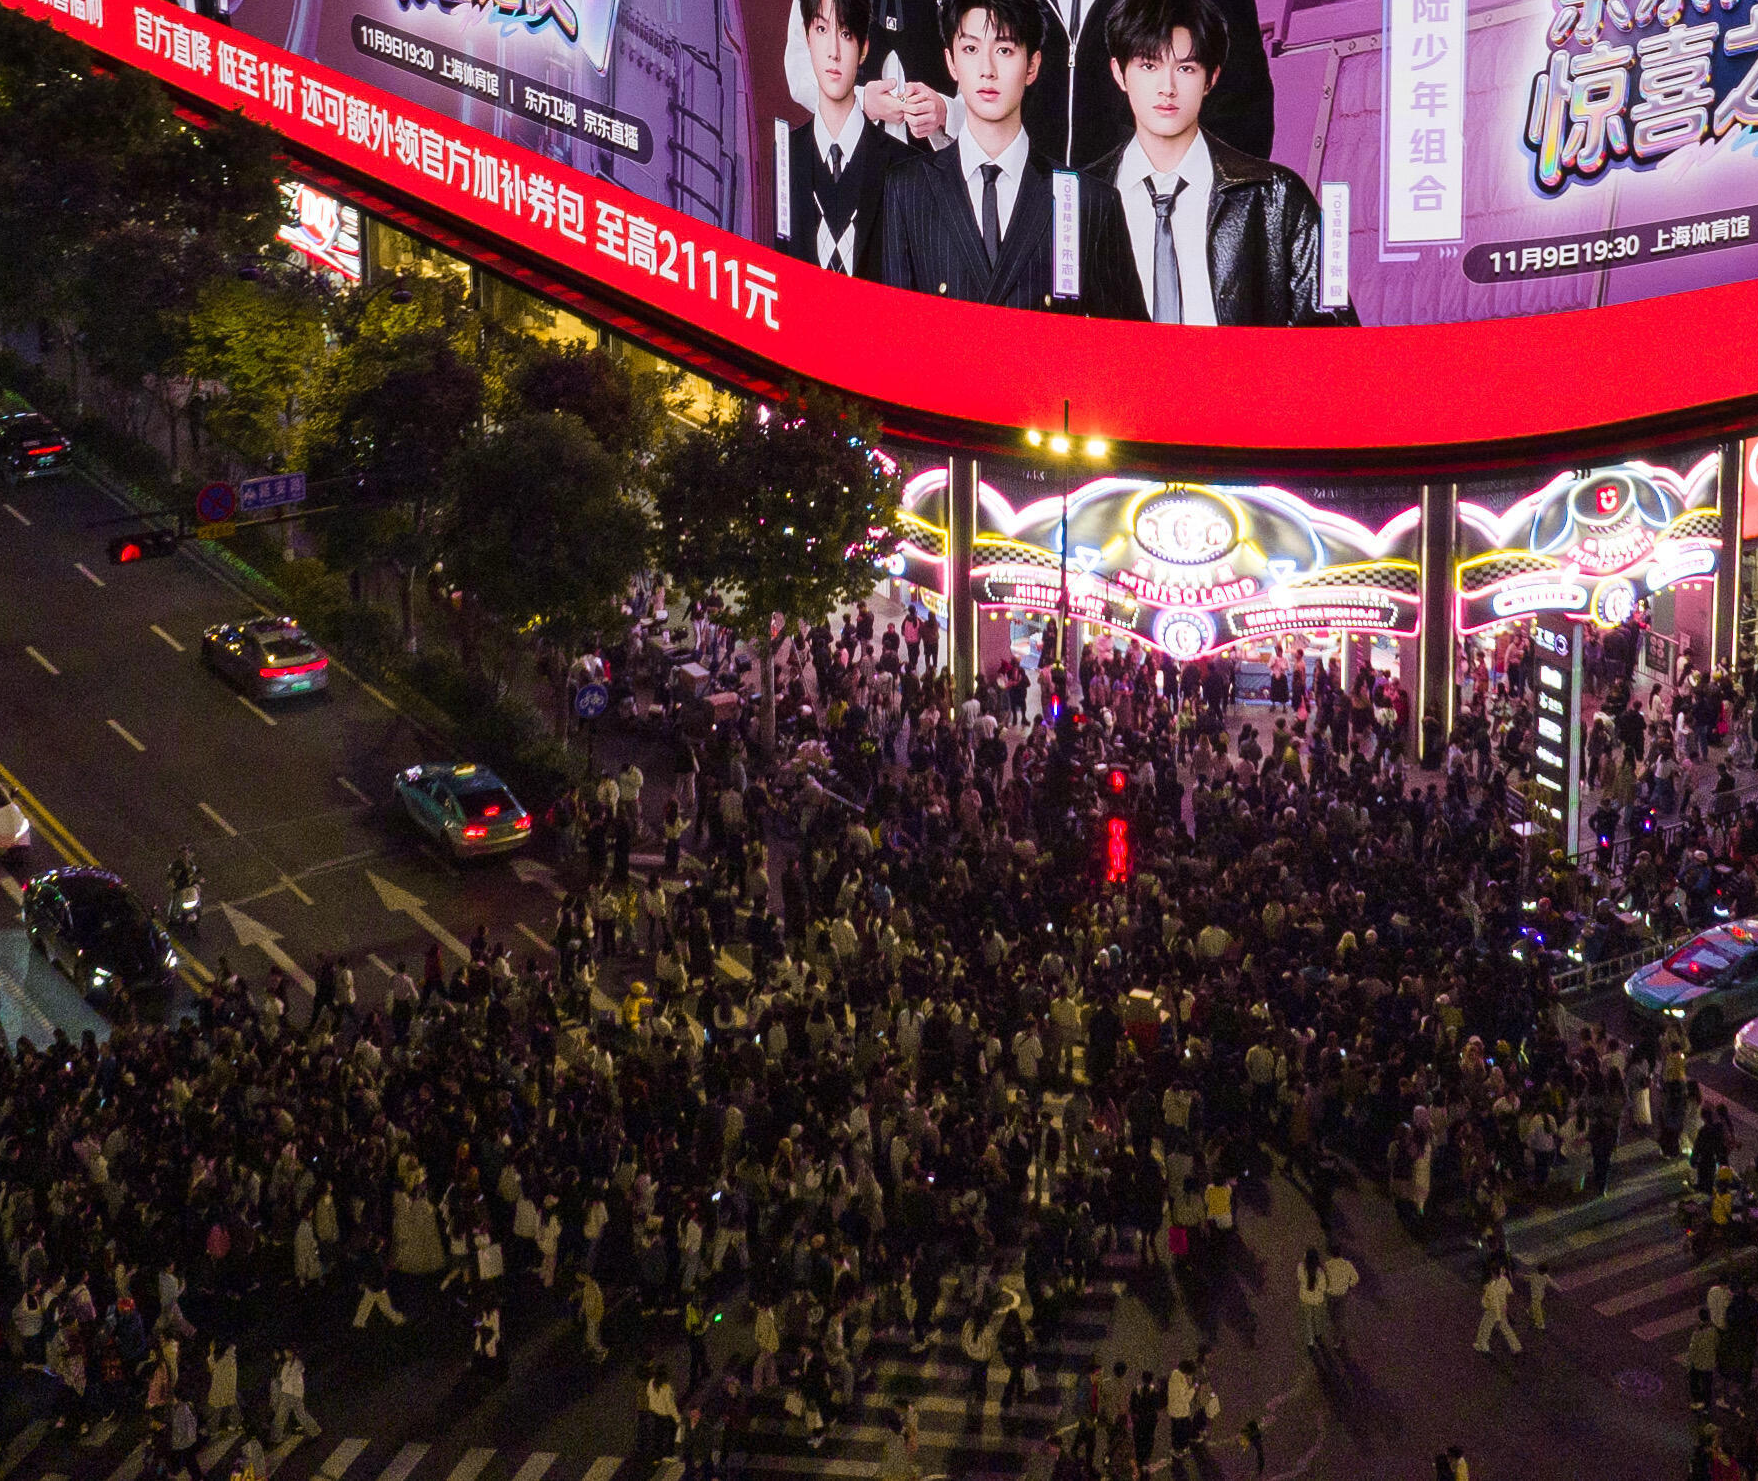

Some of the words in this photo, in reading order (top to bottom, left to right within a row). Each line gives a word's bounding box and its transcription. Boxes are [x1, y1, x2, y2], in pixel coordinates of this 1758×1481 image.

[360, 24, 435, 74] 11月9日19:30
[439, 52, 500, 97] 上海体育馆
[524, 86, 577, 128] 东方卫视
[584, 110, 639, 150] 京东直播
[133, 6, 212, 76] 官方直降
[217, 40, 295, 112] 低至1折
[299, 75, 586, 244] 还可额外领官方加补券包
[595, 200, 781, 330] 至高2111元
[1488, 234, 1641, 275] 11月9日19:30
[1650, 215, 1751, 256] 上海体育馆
[1117, 569, 1198, 606] MINISO
[1199, 576, 1257, 606] LAND
